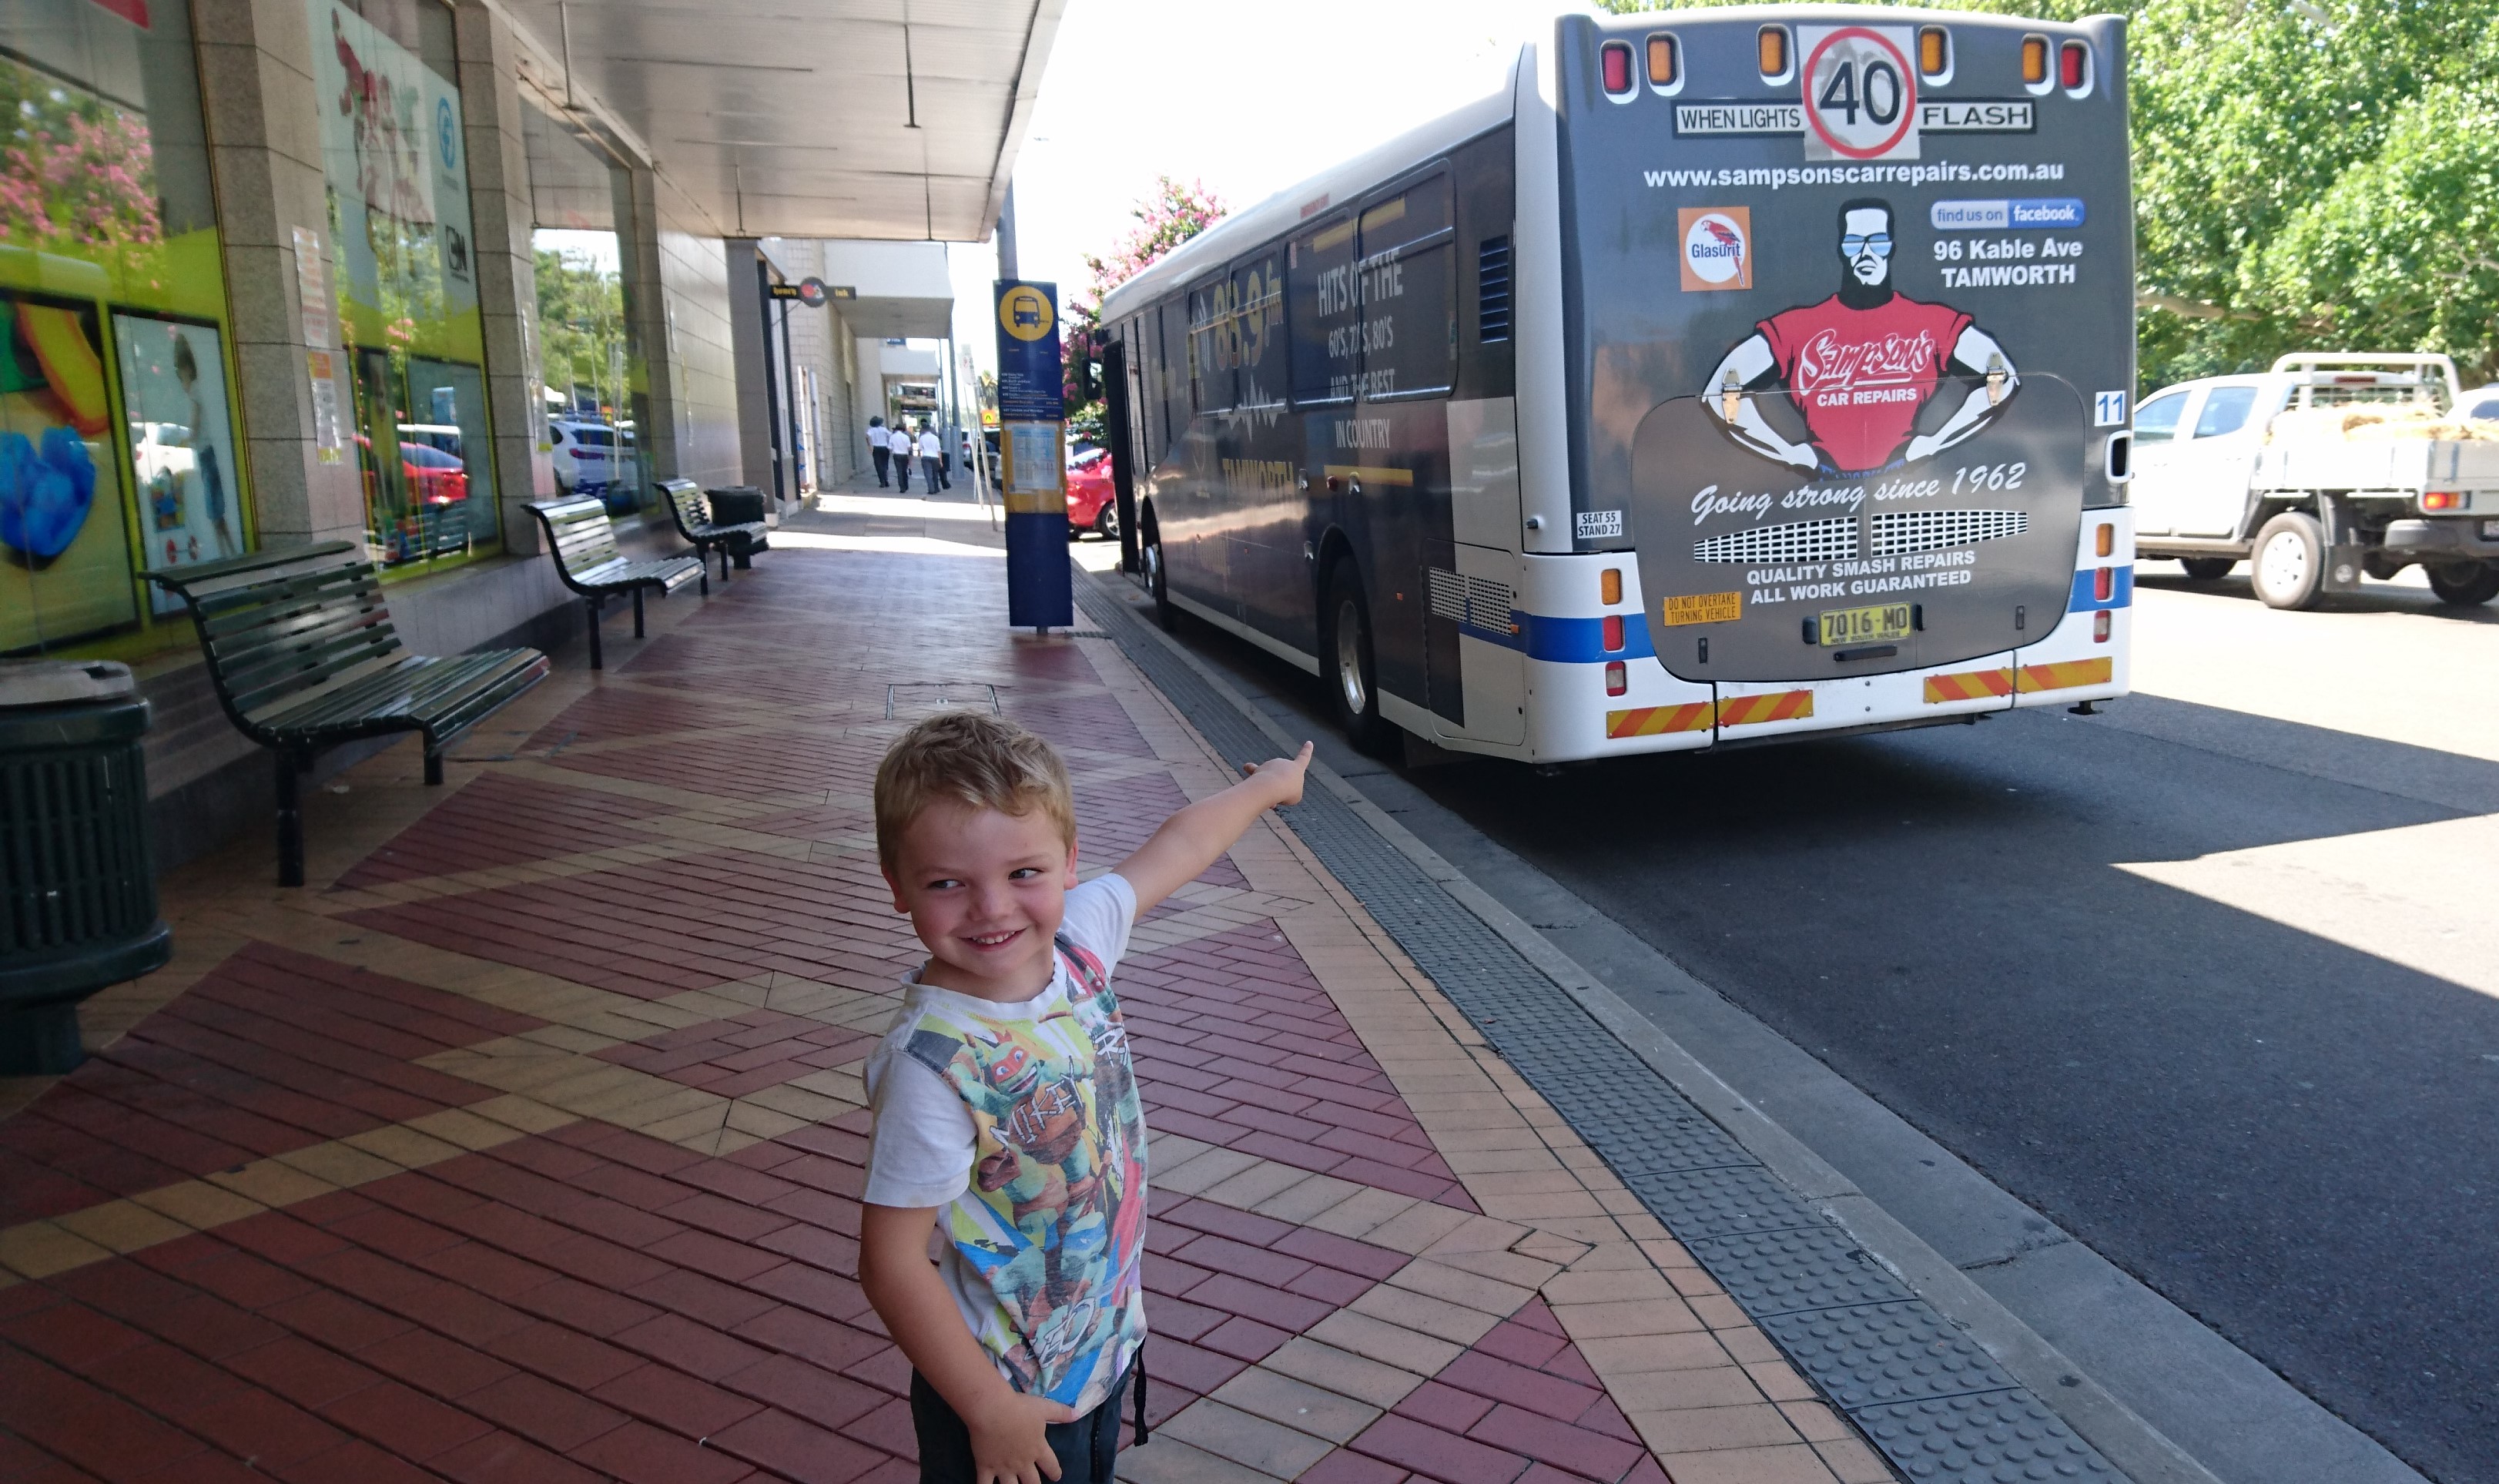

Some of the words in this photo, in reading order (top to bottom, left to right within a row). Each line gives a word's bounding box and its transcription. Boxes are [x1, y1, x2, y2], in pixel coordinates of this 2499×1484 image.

[1819, 60, 1900, 126] 40
[1681, 109, 1735, 129] WHEN
[1740, 109, 1801, 129] LIGHTS
[1924, 106, 2028, 126] FLASH
[1643, 161, 2065, 190] www.sampsonscarrepairs.com.au
[1937, 209, 1963, 222] find
[1966, 210, 1982, 222] us
[1986, 210, 2002, 221] on
[2013, 204, 2075, 222] facebook
[1691, 243, 1740, 258] Glasurit
[1934, 240, 1963, 260] 96
[1969, 238, 2035, 260] Kable
[2042, 236, 2083, 258] Ave
[1318, 265, 1347, 317] HITS
[1349, 260, 1368, 306] OF
[1368, 247, 1403, 302] THE
[1941, 263, 2076, 287] TAMWORTH
[1372, 316, 1394, 350] 80'S
[1329, 375, 1349, 403] AND
[1371, 369, 1395, 399] BEST
[1817, 392, 1849, 407] CAR
[1853, 388, 1917, 404] REPAIRS
[2096, 393, 2122, 423] 11
[1335, 420, 1345, 447] IN
[1346, 419, 1390, 448] COUNTRY
[1691, 484, 1773, 525] Going
[1780, 484, 1866, 512] strong
[1874, 478, 1940, 501] since
[1951, 462, 2026, 494] 1962
[1579, 524, 1607, 536] STAND
[1610, 524, 1620, 534] 27
[1583, 513, 1603, 524] SEAT
[1606, 512, 1616, 523] 55
[1747, 564, 1827, 586] QUALITY
[1832, 558, 1895, 578] SMASH
[1901, 551, 1975, 571] REPAIRS
[1750, 588, 1785, 605] ALL
[1791, 582, 1845, 600] WORK
[1851, 570, 1971, 595] GUARANTEED
[1669, 598, 1679, 610] DO
[1682, 596, 1695, 609] NOT
[1699, 592, 1736, 607] OVERTAKE
[1671, 609, 1702, 624] TURNING
[1706, 606, 1736, 620] VEHICLE
[990, 1055, 1084, 1147] MIKEY
